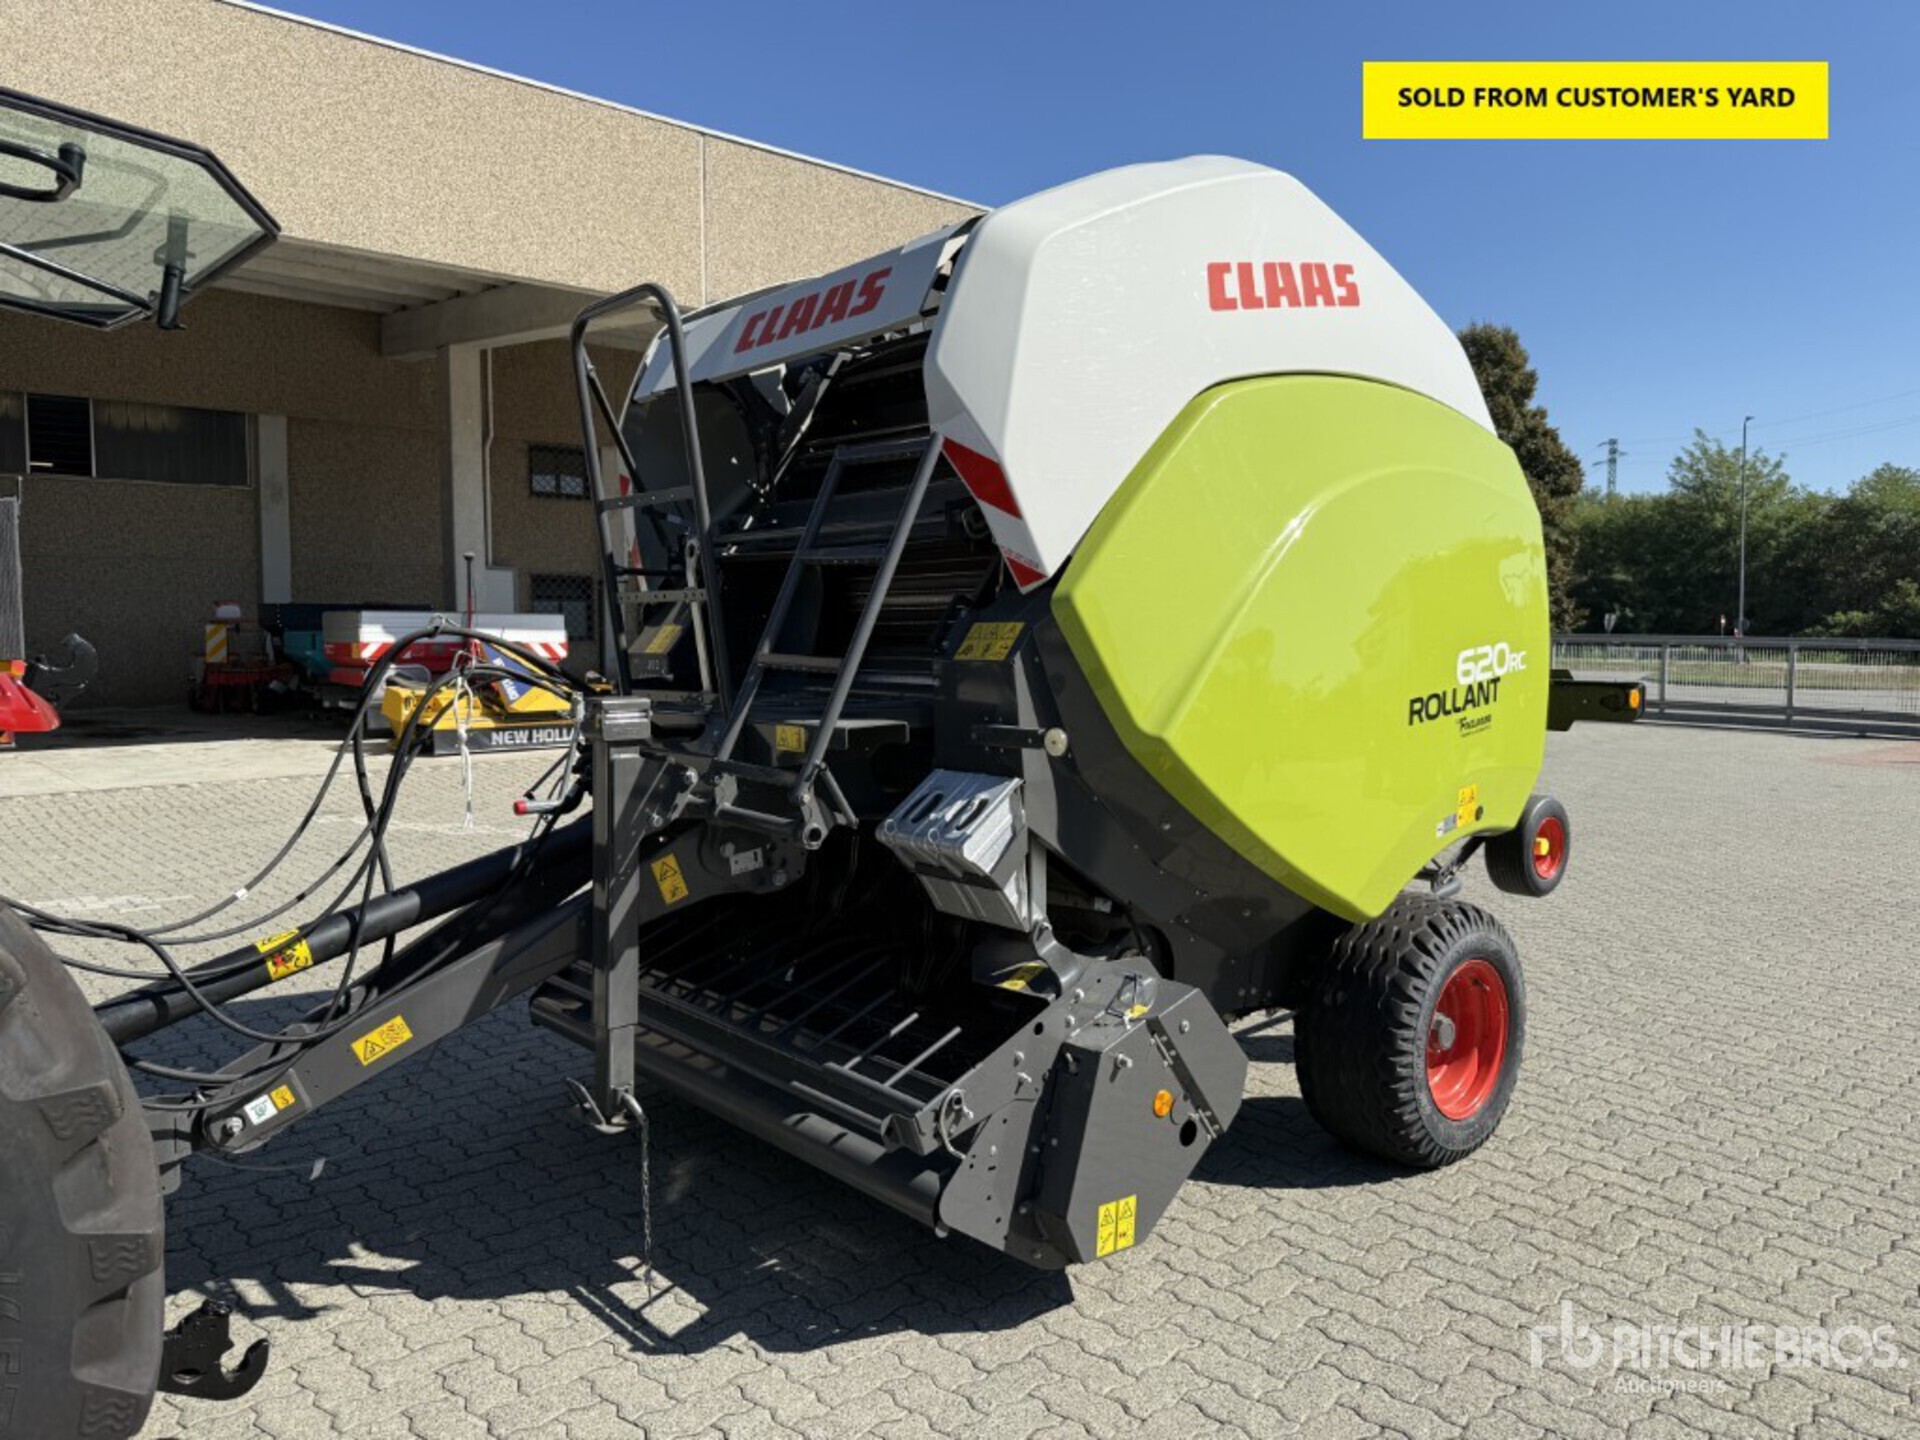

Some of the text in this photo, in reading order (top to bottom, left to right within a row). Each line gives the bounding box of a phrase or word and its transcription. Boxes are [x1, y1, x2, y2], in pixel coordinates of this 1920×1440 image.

[734, 267, 893, 353] CLAAS
[1207, 261, 1361, 312] CLAAS
[1408, 677, 1501, 726] ROLLANT
[491, 730, 529, 745] NEW
